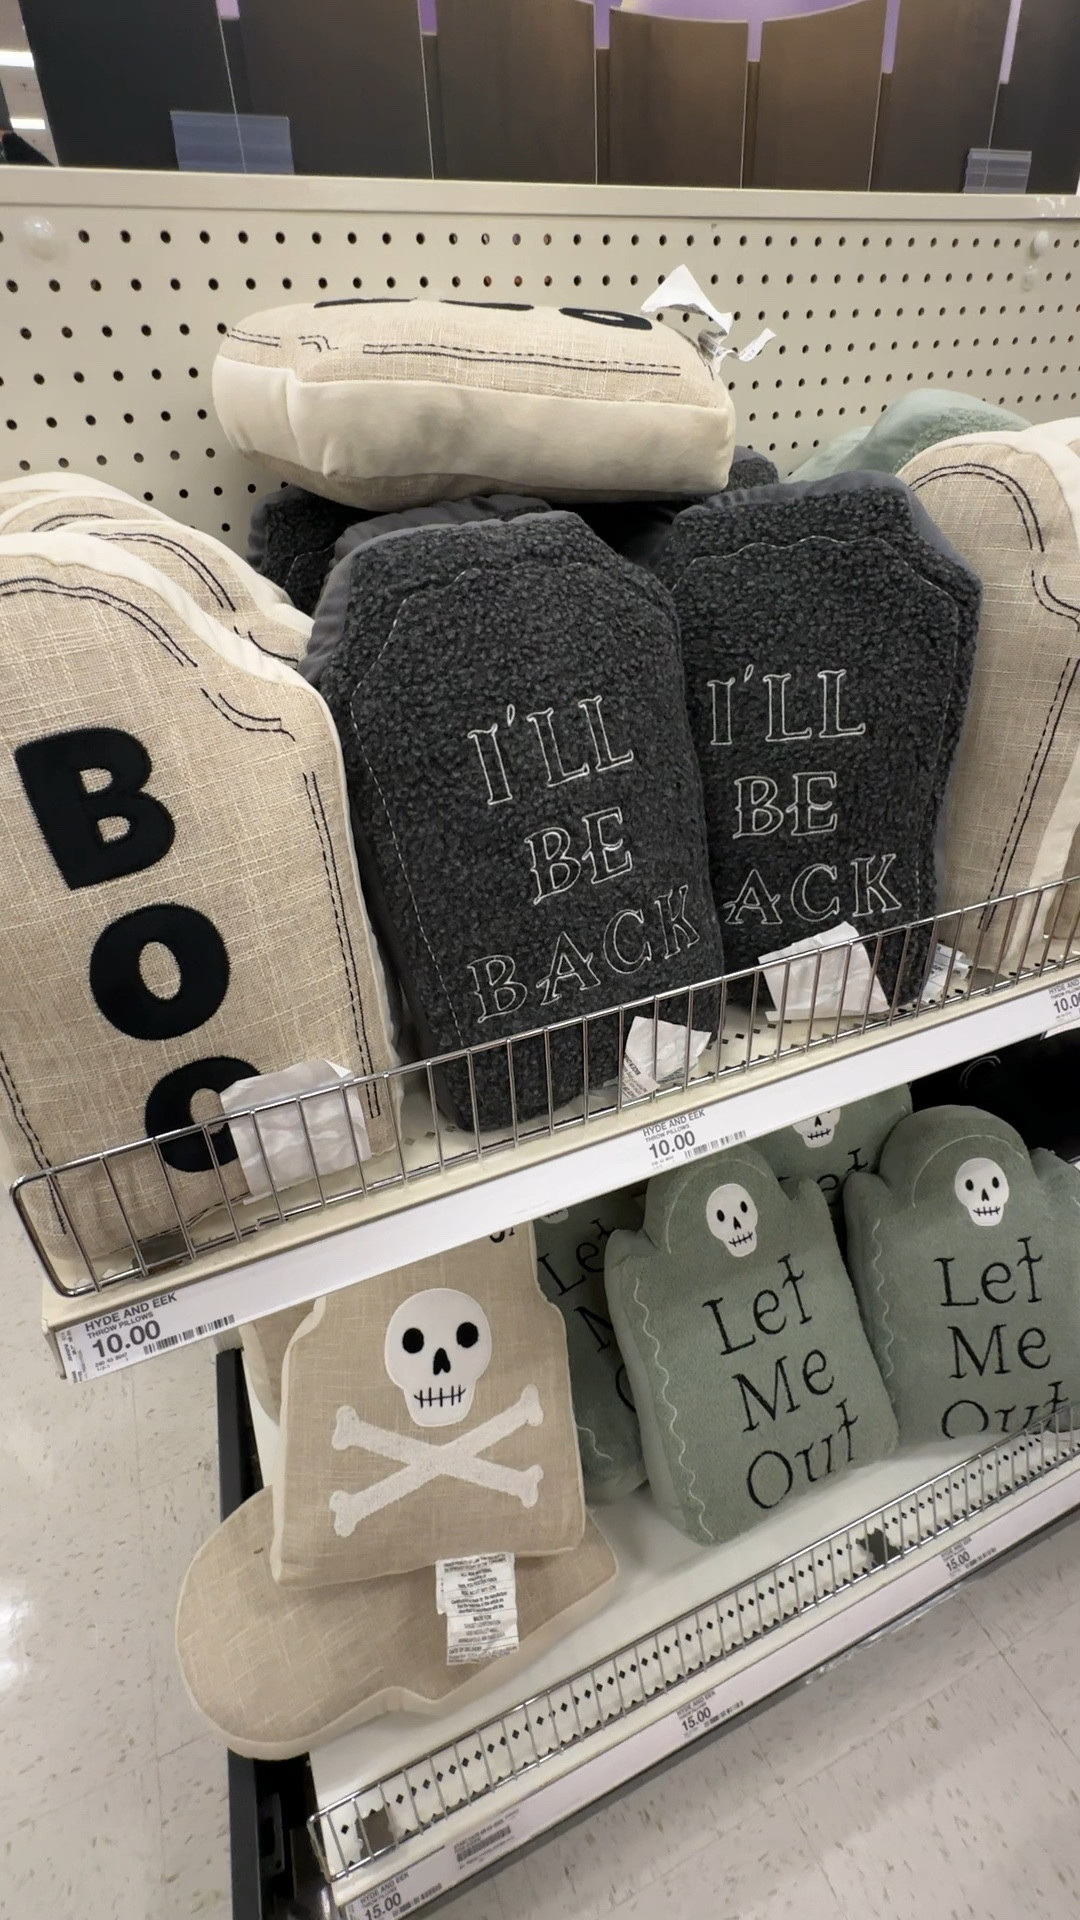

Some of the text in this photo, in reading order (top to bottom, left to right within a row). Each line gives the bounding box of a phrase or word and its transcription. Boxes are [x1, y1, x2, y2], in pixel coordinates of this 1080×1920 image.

[707, 664, 867, 746] I'LL
[467, 695, 635, 806] I'LL
[732, 771, 838, 839] BE
[524, 807, 633, 904] BE
[723, 853, 902, 924] ACK
[466, 885, 700, 1023] BACK
[1054, 991, 1080, 1013] 10.0
[643, 1109, 706, 1137] HYDE AND EEK
[645, 1124, 690, 1143] THROW PILLOWS
[649, 1130, 695, 1159] 10.00
[933, 1236, 1042, 1307] Let
[85, 1292, 177, 1332] HYDE AND EEK
[87, 1312, 154, 1340] THROW PILLOWS
[702, 1254, 812, 1355] Let
[92, 1319, 161, 1358] 10.00
[948, 1323, 1052, 1379] Me
[731, 1349, 834, 1433] Me
[941, 1381, 1069, 1439] Out
[746, 1399, 858, 1509] Out
[946, 1551, 970, 1571] 15.00
[682, 1707, 711, 1731] 15.00
[365, 1892, 401, 1920] 15.00
